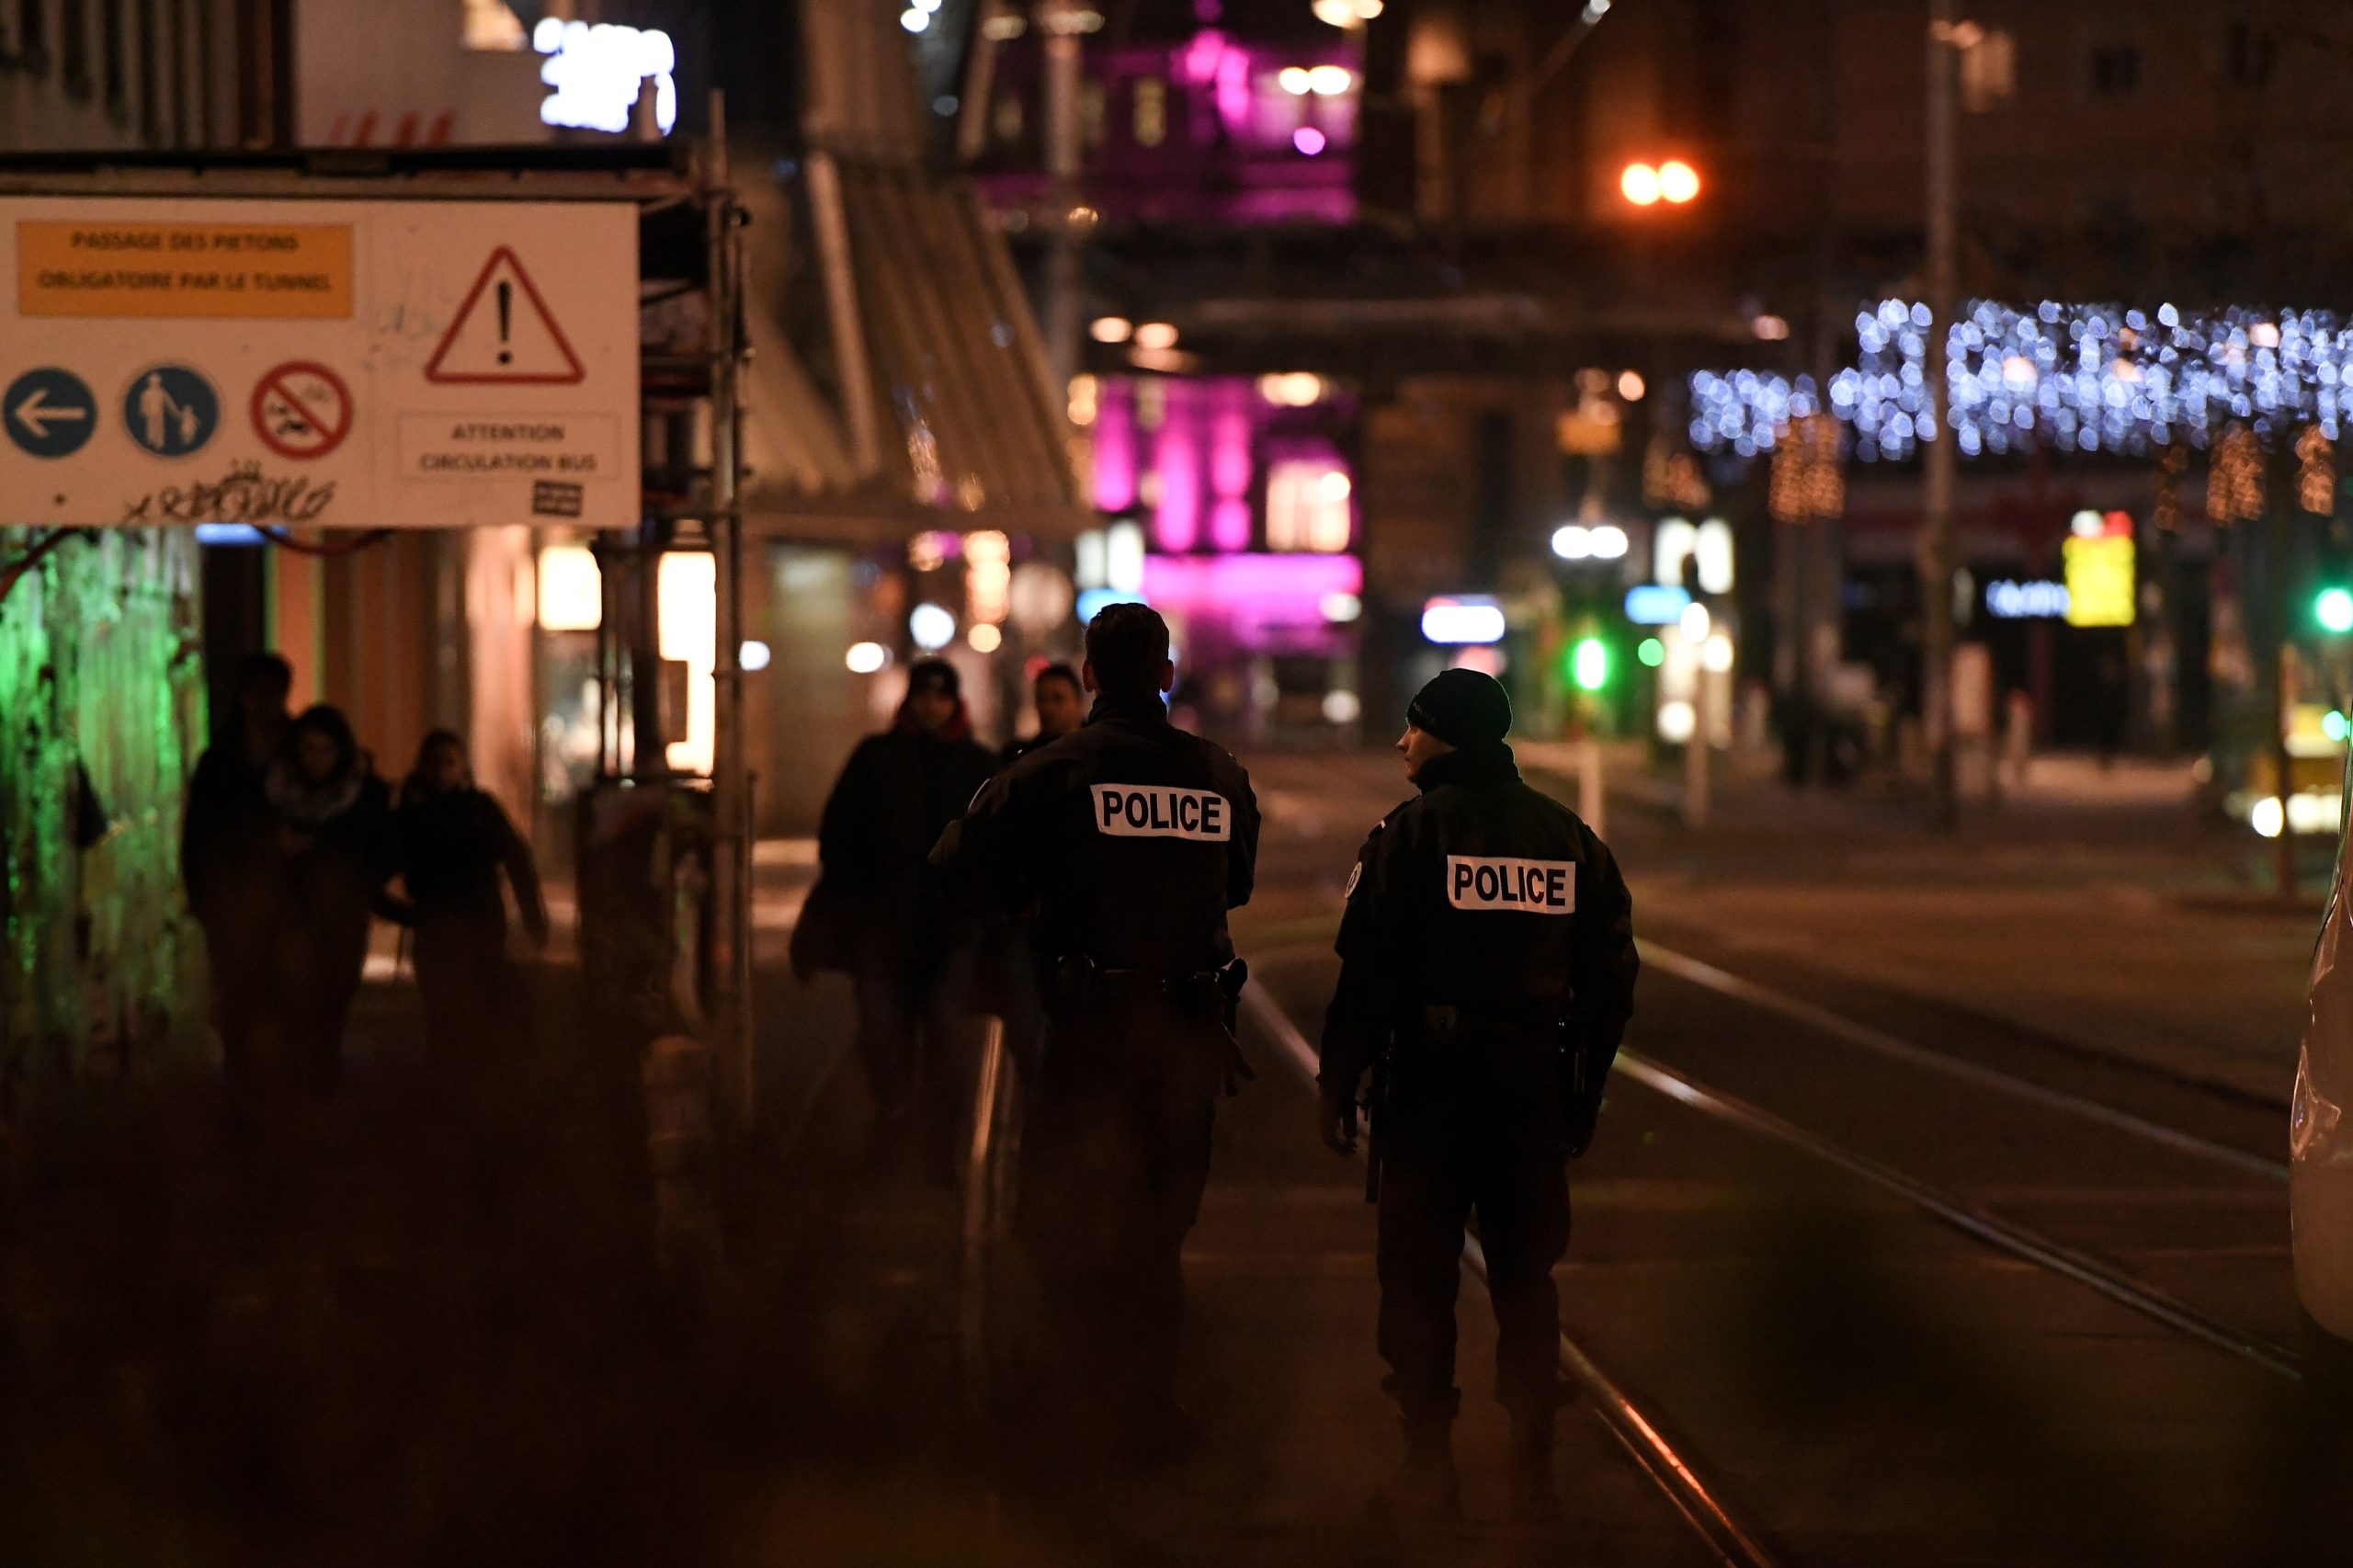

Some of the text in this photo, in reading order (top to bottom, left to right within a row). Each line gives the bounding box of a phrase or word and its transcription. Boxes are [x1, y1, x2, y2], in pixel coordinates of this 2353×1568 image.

[72, 232, 162, 251] PASSAGE
[169, 233, 208, 252] DES
[37, 271, 332, 292] OBLIGATOIRE PAR LE TUNNEL
[450, 423, 565, 440] ATTENTION
[418, 452, 598, 472] CIRCULATION BUS
[1102, 790, 1222, 834] POLICE
[1454, 863, 1566, 906] POLICE
